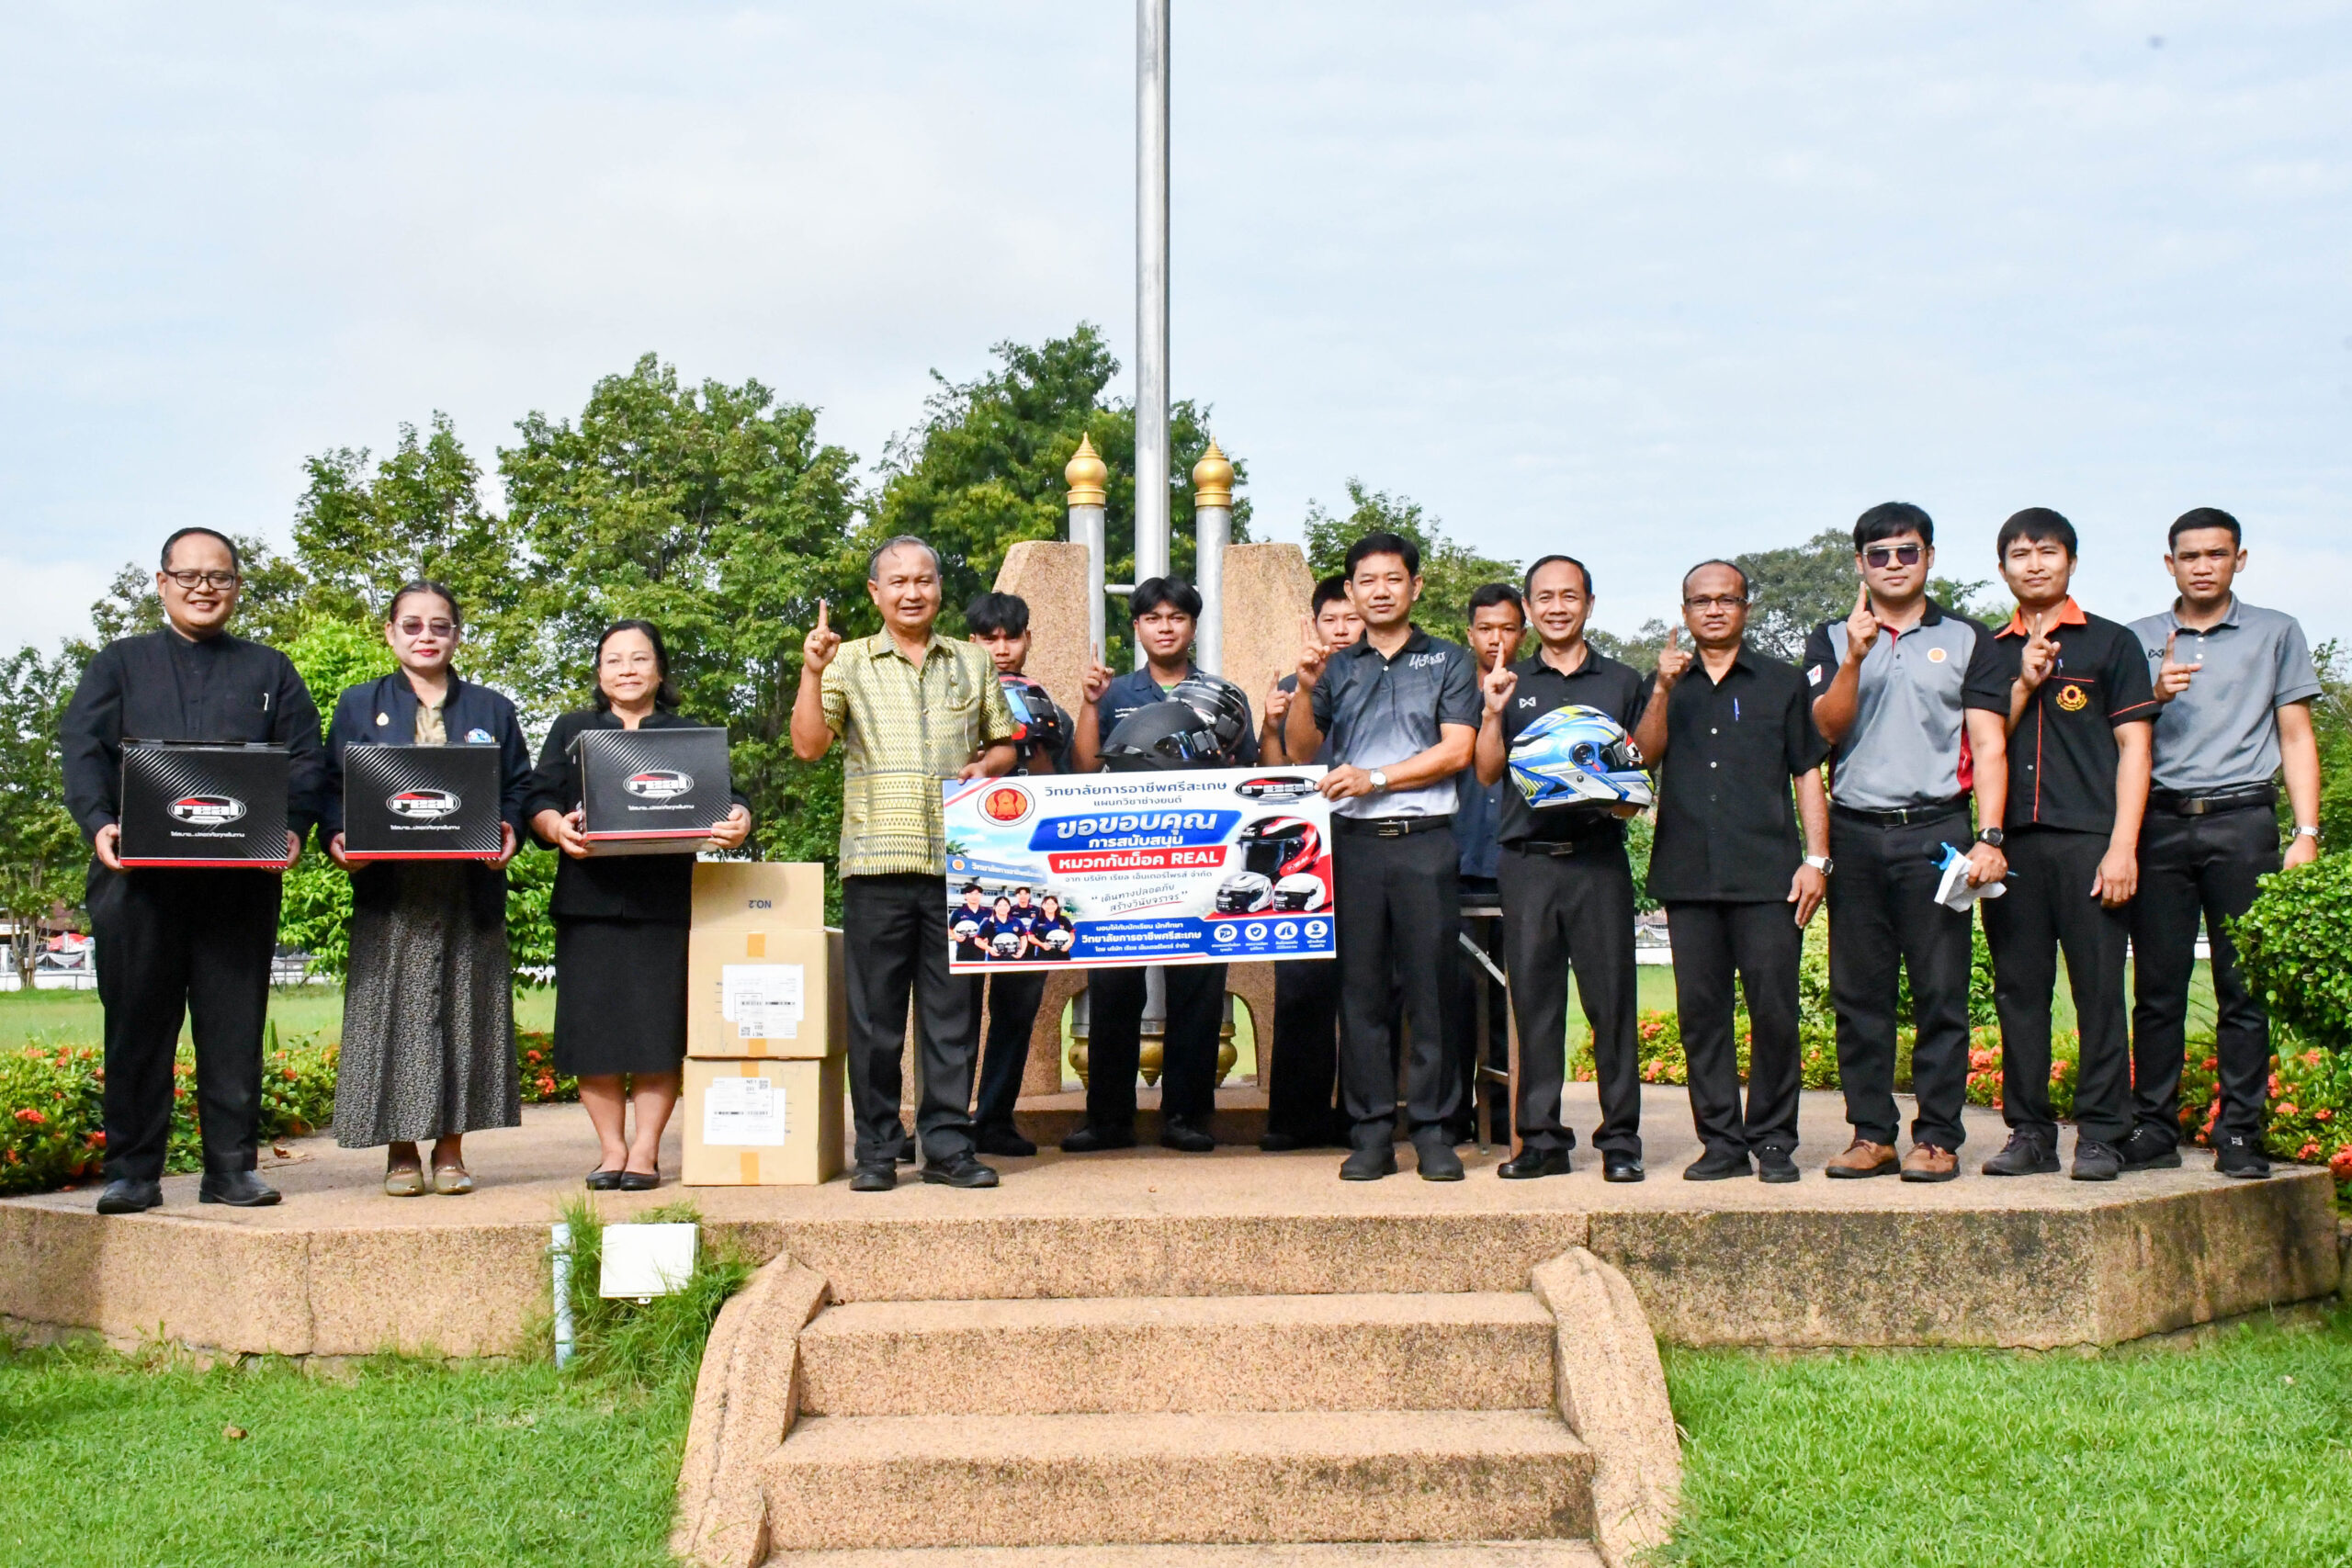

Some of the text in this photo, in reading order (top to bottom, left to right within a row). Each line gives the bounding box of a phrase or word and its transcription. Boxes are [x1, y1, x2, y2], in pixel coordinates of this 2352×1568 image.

[1045, 781, 1227, 796] วิทยาลัยการอาชีพศรีสะเกษ
[1093, 795, 1182, 807] แผนกวิชาช่างยนต์
[1057, 812, 1218, 840] ขอขอบคุณ
[1088, 833, 1183, 849] การสนับสนุน
[1058, 851, 1219, 870] หมวกกันน็อค REAL
[1083, 874, 1108, 883] บริษัท
[1110, 873, 1130, 881] เรียล
[1191, 870, 1213, 879] จำกัด
[748, 899, 772, 909] NO.2
[1081, 931, 1203, 944] วิทยาลัยการอาชีพศรีสะเกษ
